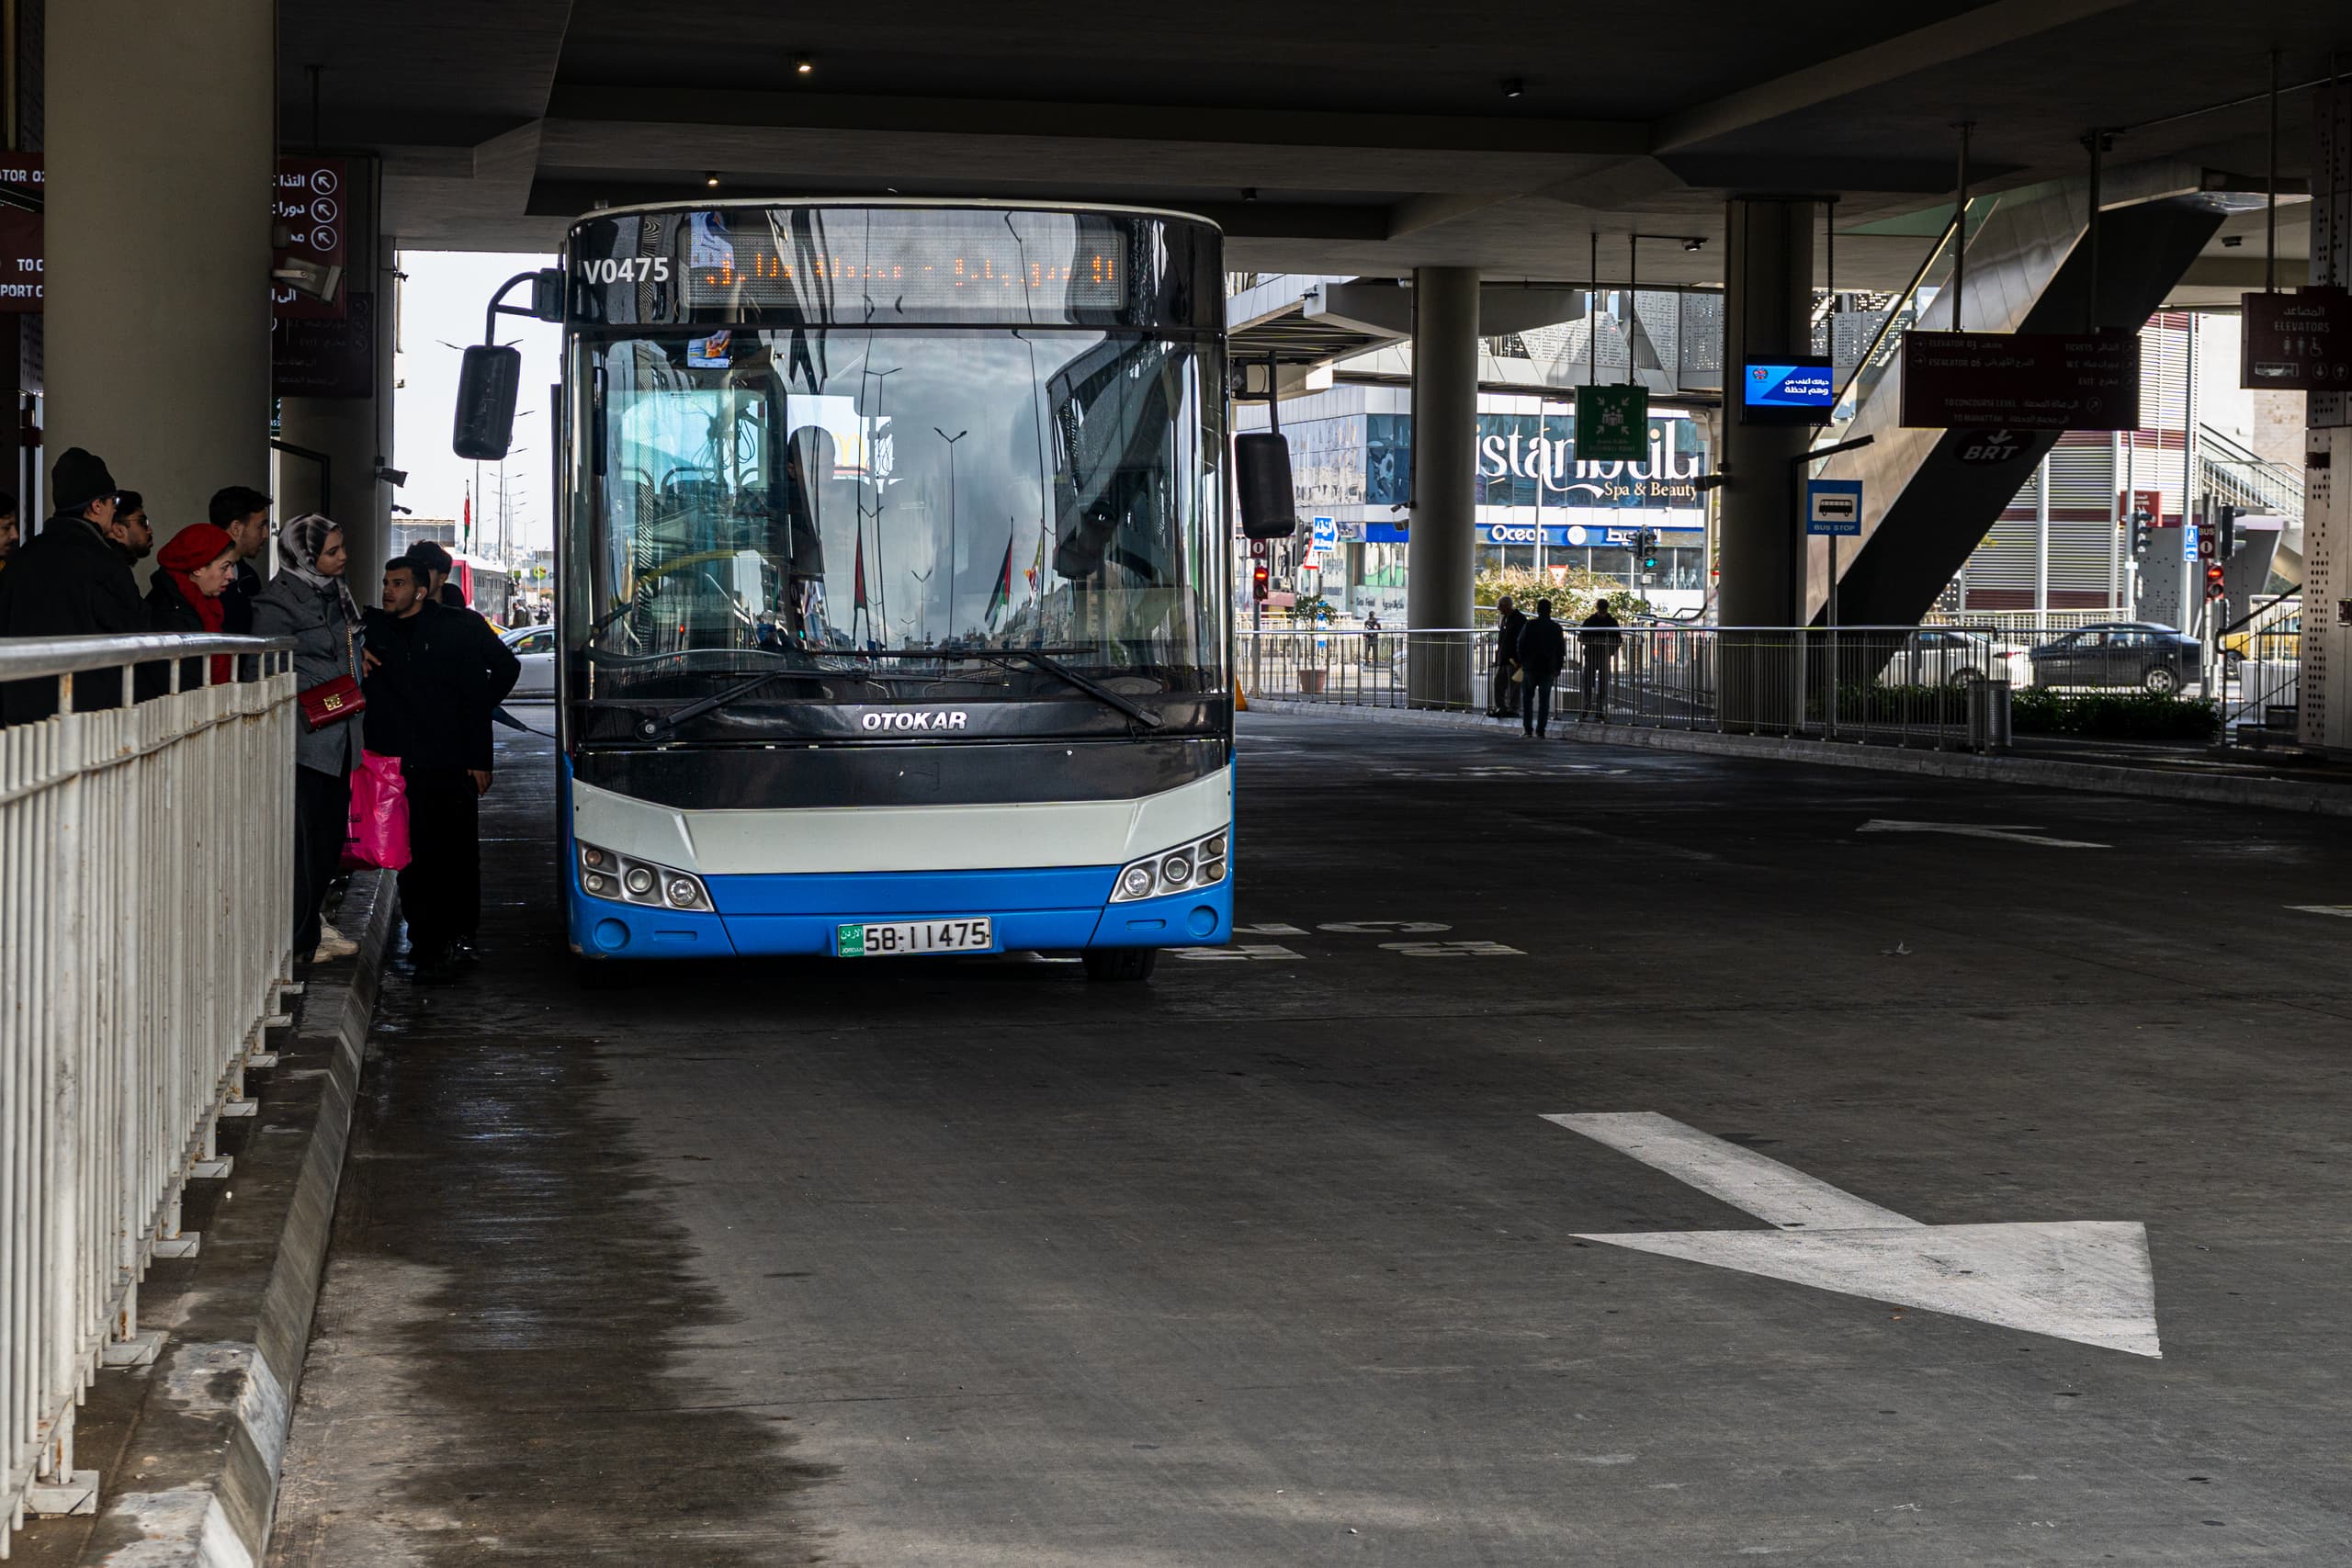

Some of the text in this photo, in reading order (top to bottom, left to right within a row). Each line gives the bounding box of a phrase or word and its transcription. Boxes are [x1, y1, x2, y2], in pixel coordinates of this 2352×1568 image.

[17, 258, 34, 271] TO
[583, 256, 670, 285] V0475
[2274, 321, 2331, 333] ELEVATORS
[1784, 386, 1807, 394] لحظة
[1962, 445, 2020, 460] BRT
[1604, 481, 1697, 502] Spa & Beauty
[1491, 525, 1548, 542] Ocean
[1833, 524, 1856, 532] STOP
[2199, 527, 2215, 536] BUS
[862, 711, 968, 731] OTOKAR
[841, 946, 865, 955] JORDAN
